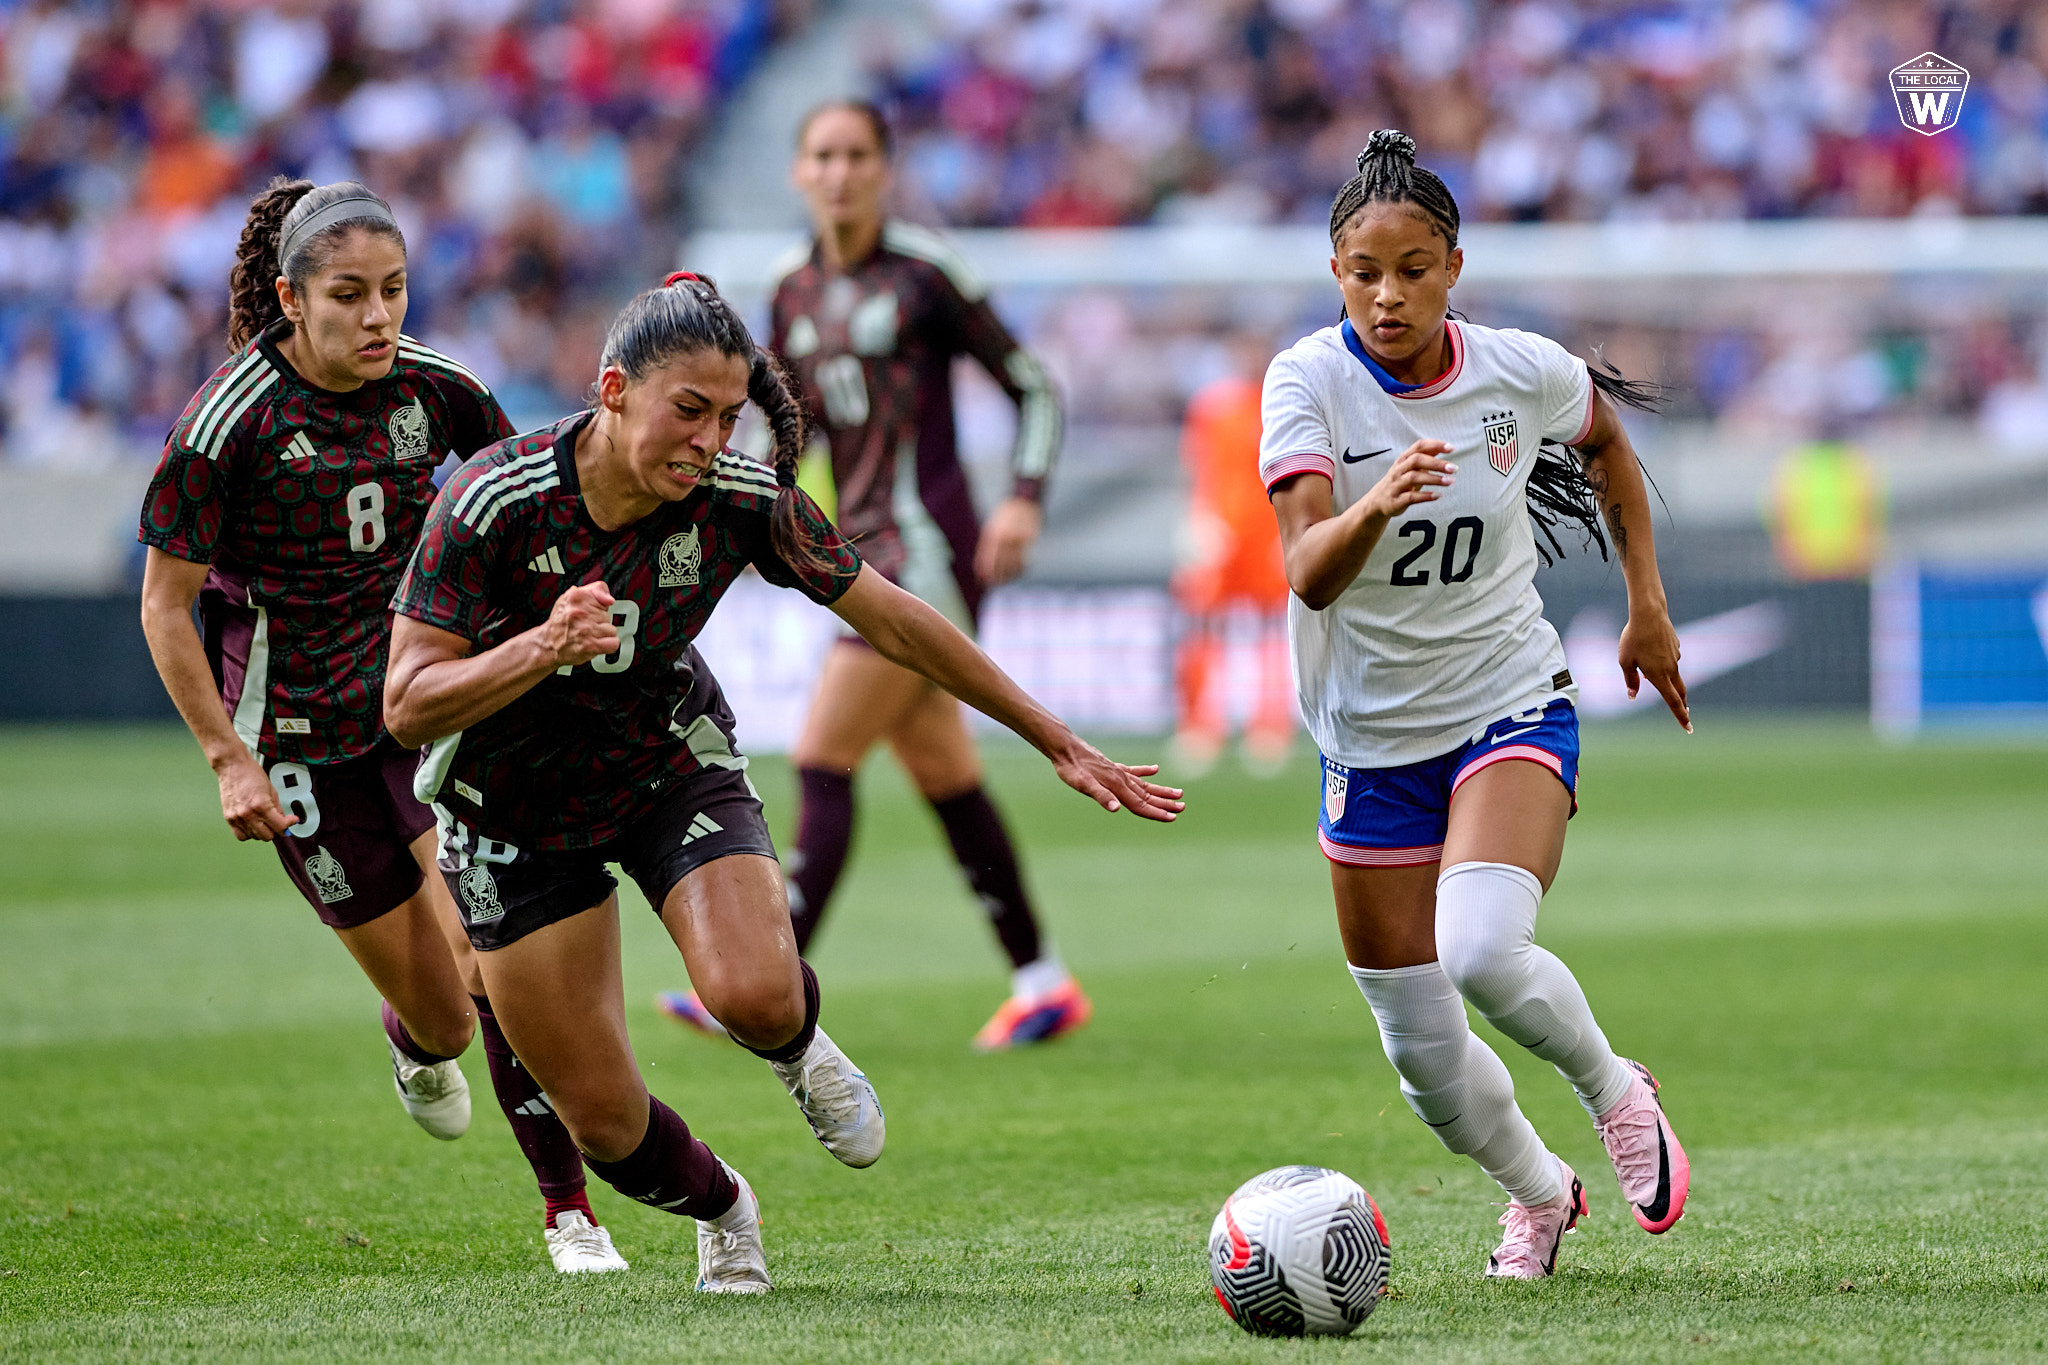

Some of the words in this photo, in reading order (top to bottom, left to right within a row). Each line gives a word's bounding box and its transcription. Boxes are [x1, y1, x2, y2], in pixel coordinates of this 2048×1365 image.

[1488, 424, 1515, 446] USA
[346, 481, 386, 553] 8
[1389, 515, 1484, 586] 20
[556, 599, 640, 676] 8
[269, 761, 321, 839] 8
[1327, 772, 1346, 795] USA
